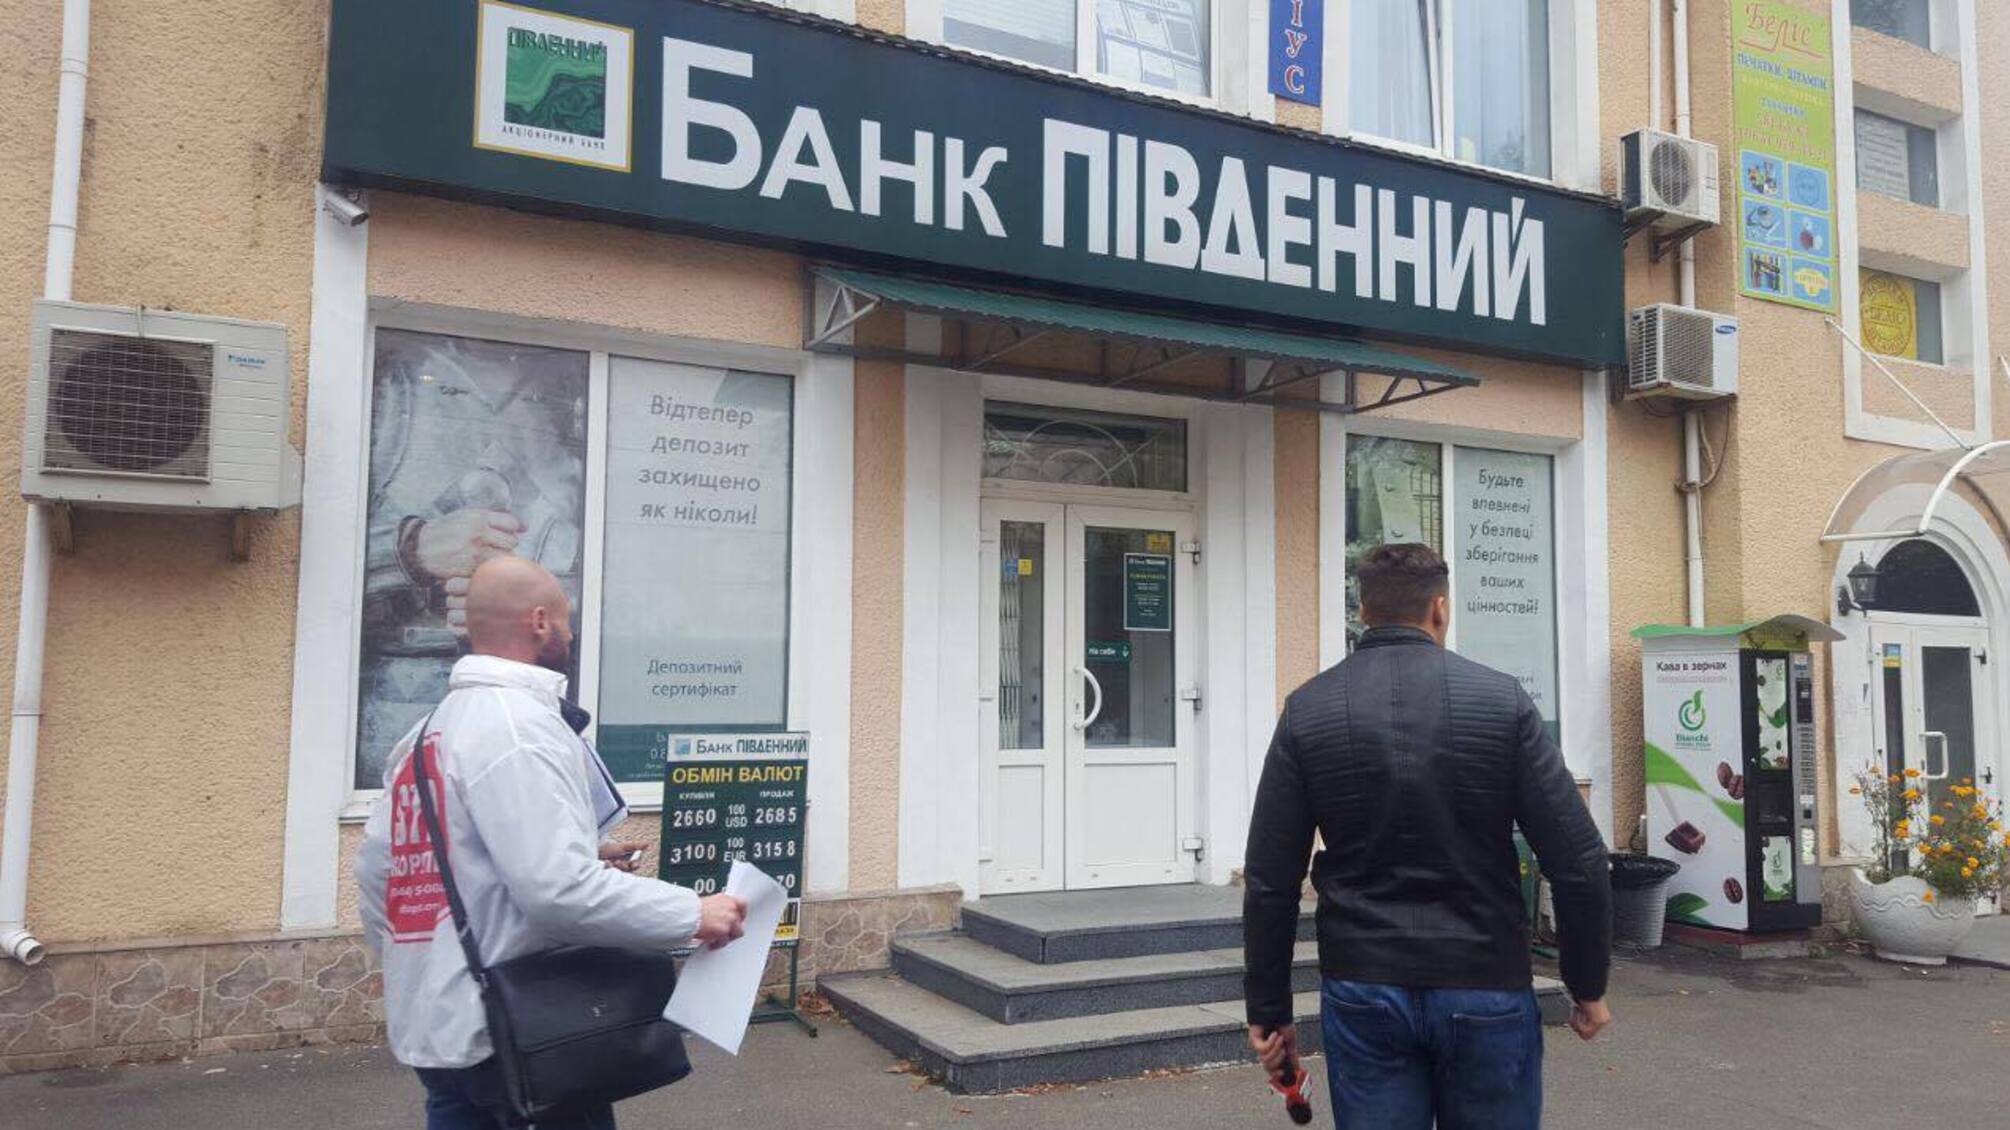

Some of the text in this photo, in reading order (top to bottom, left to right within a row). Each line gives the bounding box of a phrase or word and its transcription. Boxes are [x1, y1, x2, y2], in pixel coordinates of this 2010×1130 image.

[1043, 117, 1546, 326] ПІВДЕННИЙ
[650, 394, 754, 430] Відтепер
[650, 435, 751, 458] депозит
[638, 468, 761, 492] захищено
[1478, 469, 1524, 489] Будьте
[640, 500, 758, 525] як ніколи!
[1472, 497, 1531, 514] впевнені
[1469, 519, 1535, 540] у безпеці
[1466, 546, 1540, 564] зберігання
[1480, 575, 1525, 590] ваших
[1467, 598, 1539, 616] цінностей!
[647, 659, 743, 676] Депозитний
[1656, 661, 1681, 672] Кава
[651, 683, 739, 699] сертифікат
[735, 737, 808, 754] ПІВДЕННИЙ
[672, 765, 804, 784] ОБМІН ВАЛЮТ
[673, 804, 797, 828] 2660 100 2685
[725, 816, 748, 829] USD
[670, 838, 796, 864] 3100 100 3158
[723, 851, 747, 863] EUR
